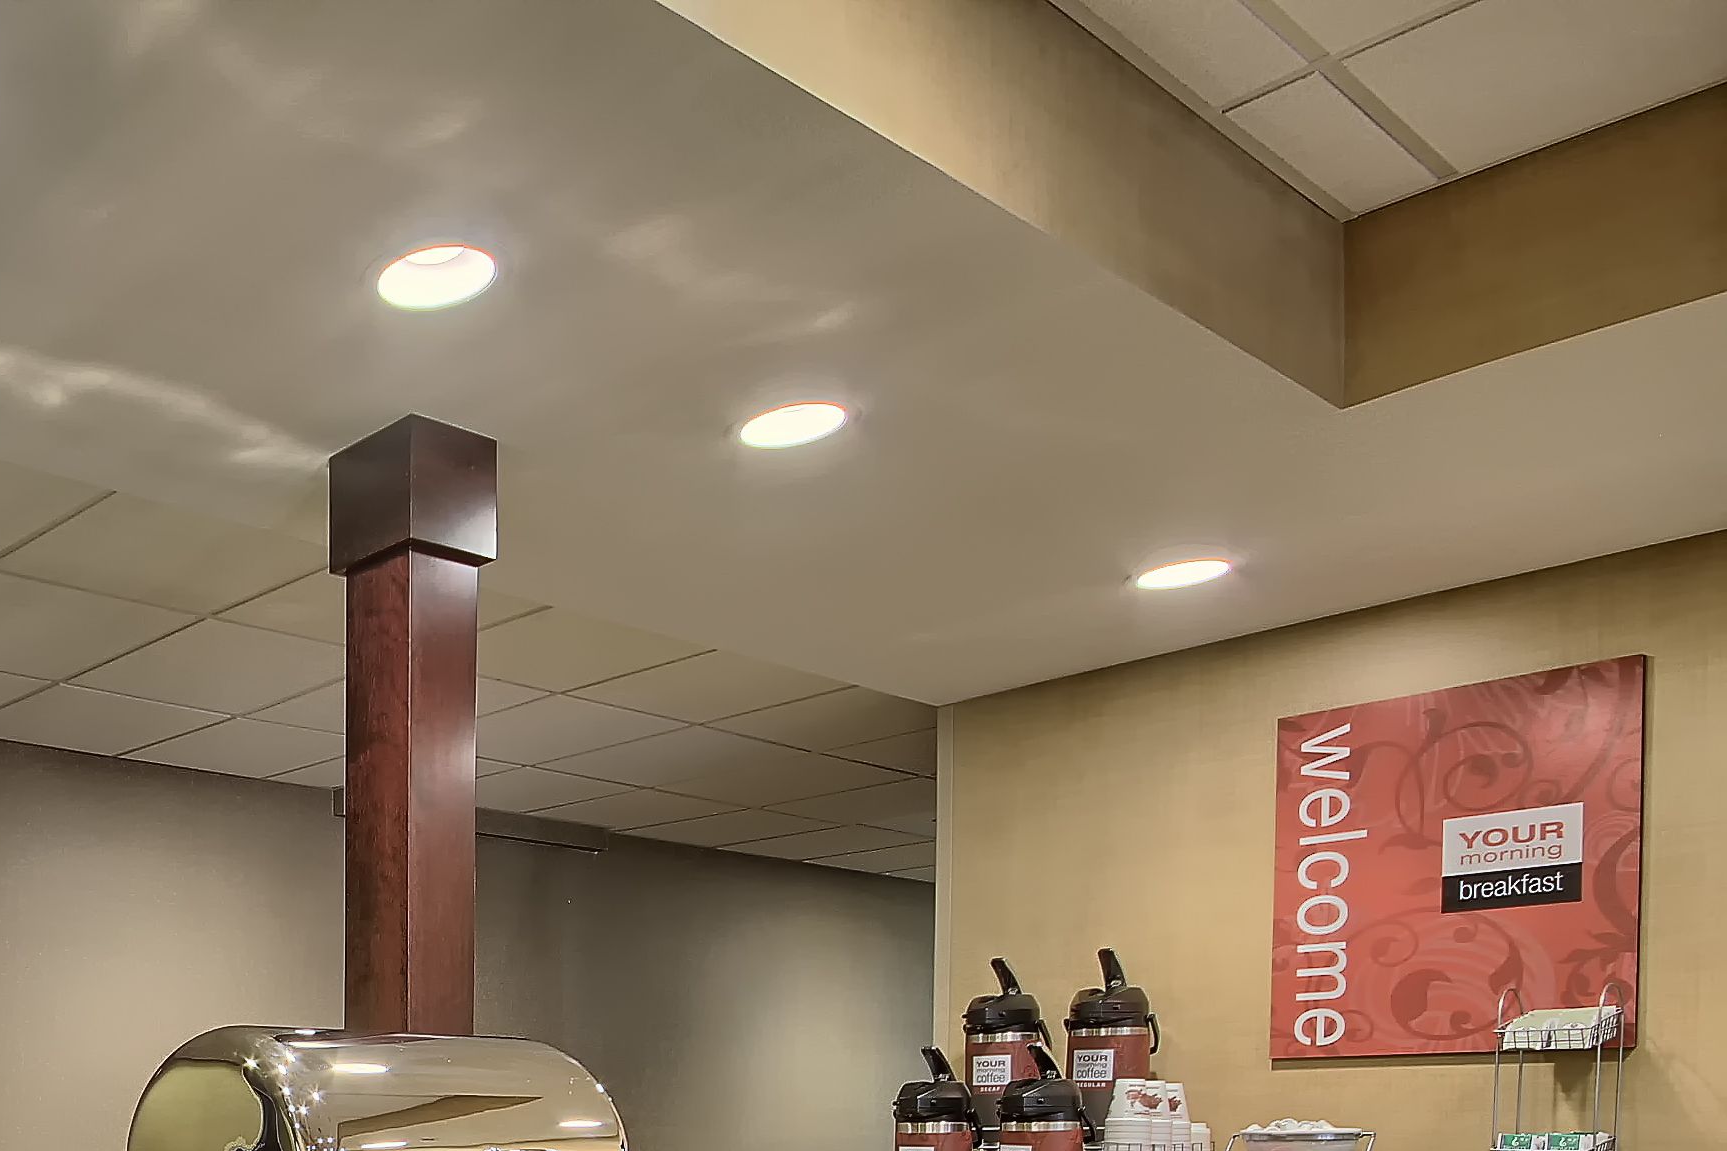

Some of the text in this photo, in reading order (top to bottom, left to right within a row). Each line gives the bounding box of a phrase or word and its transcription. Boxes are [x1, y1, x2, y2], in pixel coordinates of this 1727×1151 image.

[1458, 821, 1565, 850] YOUR
[1460, 844, 1563, 865] morning
[1293, 722, 1368, 1047] welcome
[1459, 871, 1565, 901] breakfast
[976, 1060, 1006, 1068] YOUR
[1077, 1054, 1108, 1062] YOUR
[976, 1072, 1006, 1083] coffee
[1076, 1067, 1107, 1078] coffee
